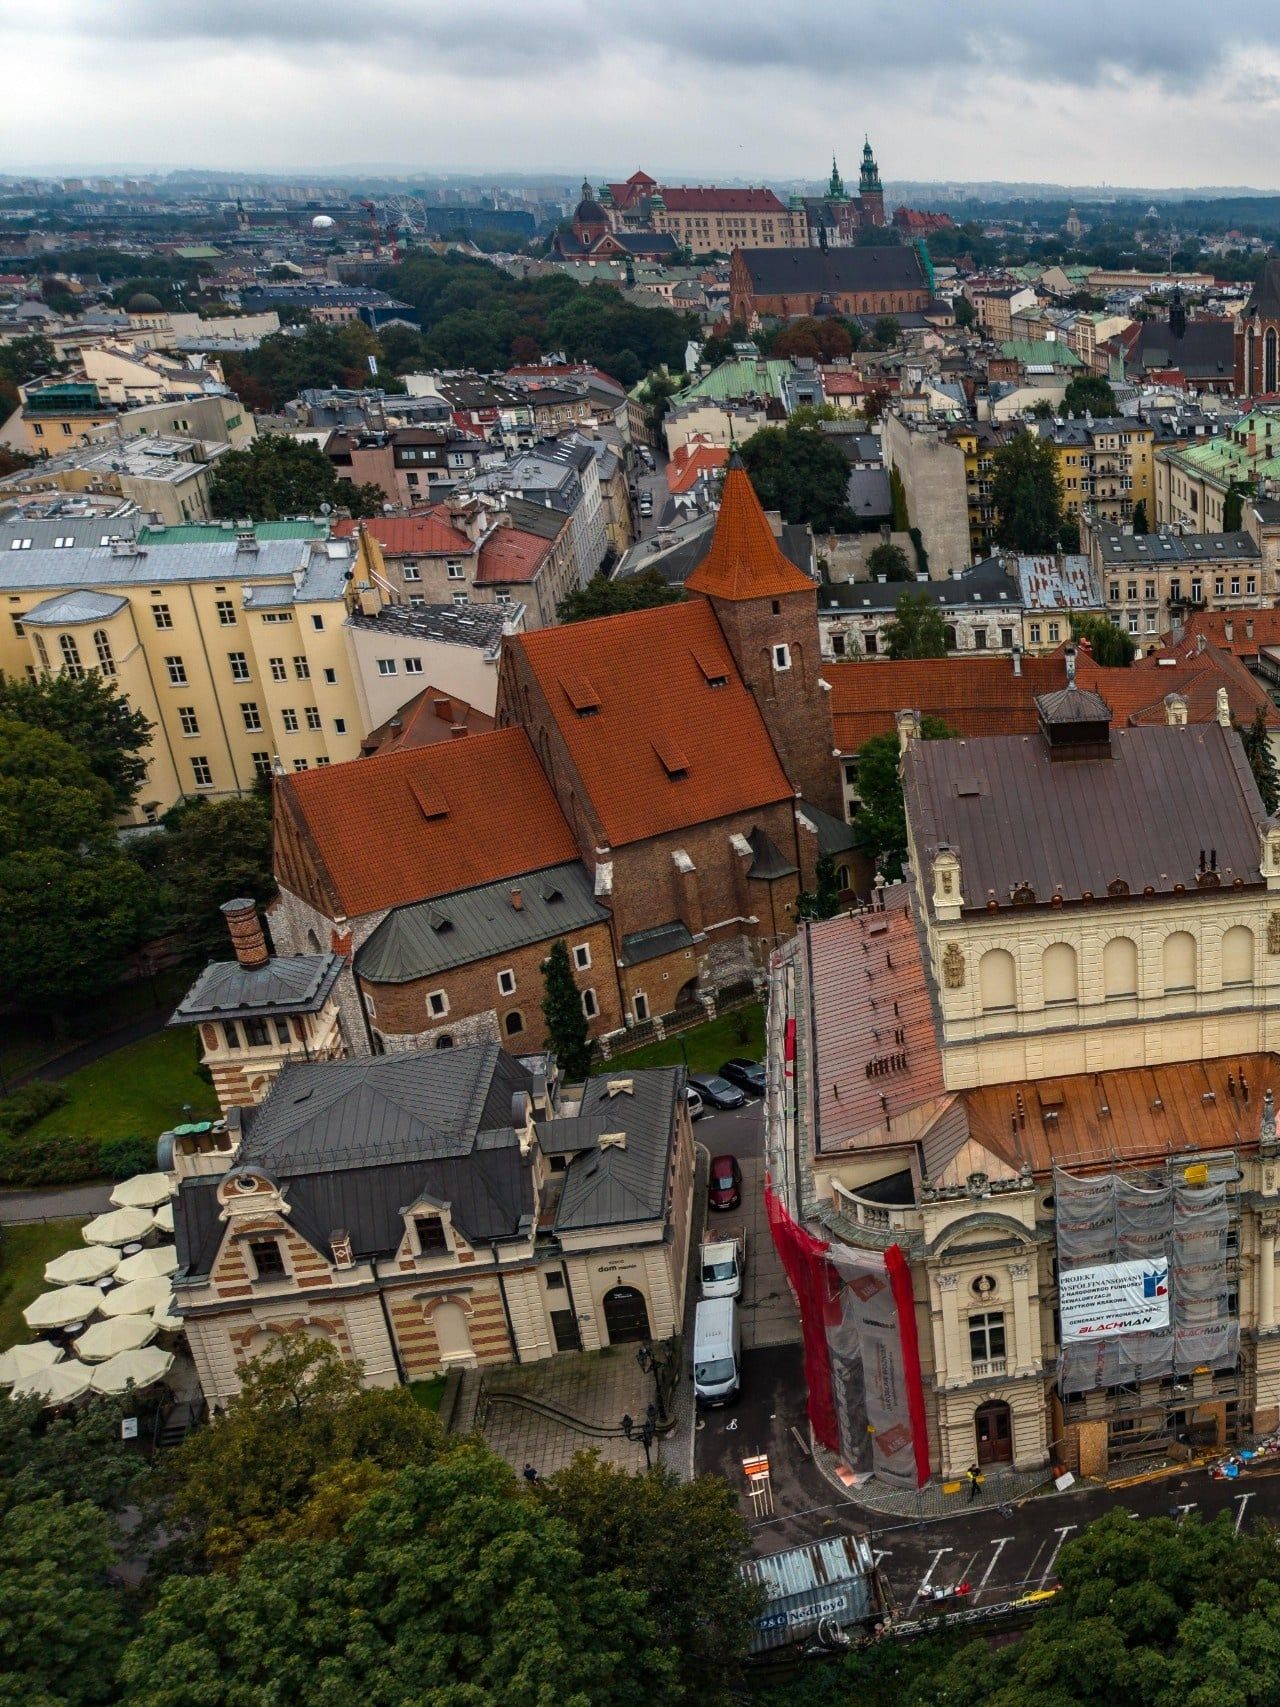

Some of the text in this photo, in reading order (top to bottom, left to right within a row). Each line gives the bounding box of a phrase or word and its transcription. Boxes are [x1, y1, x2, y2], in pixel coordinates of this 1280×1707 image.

[1060, 1273, 1096, 1284] PROJEKT
[1062, 1298, 1127, 1311] ZABYTKÓW KRAKOWA
[1069, 1316, 1104, 1326] GENERALNY
[1079, 1316, 1152, 1334] BLACHMAN
